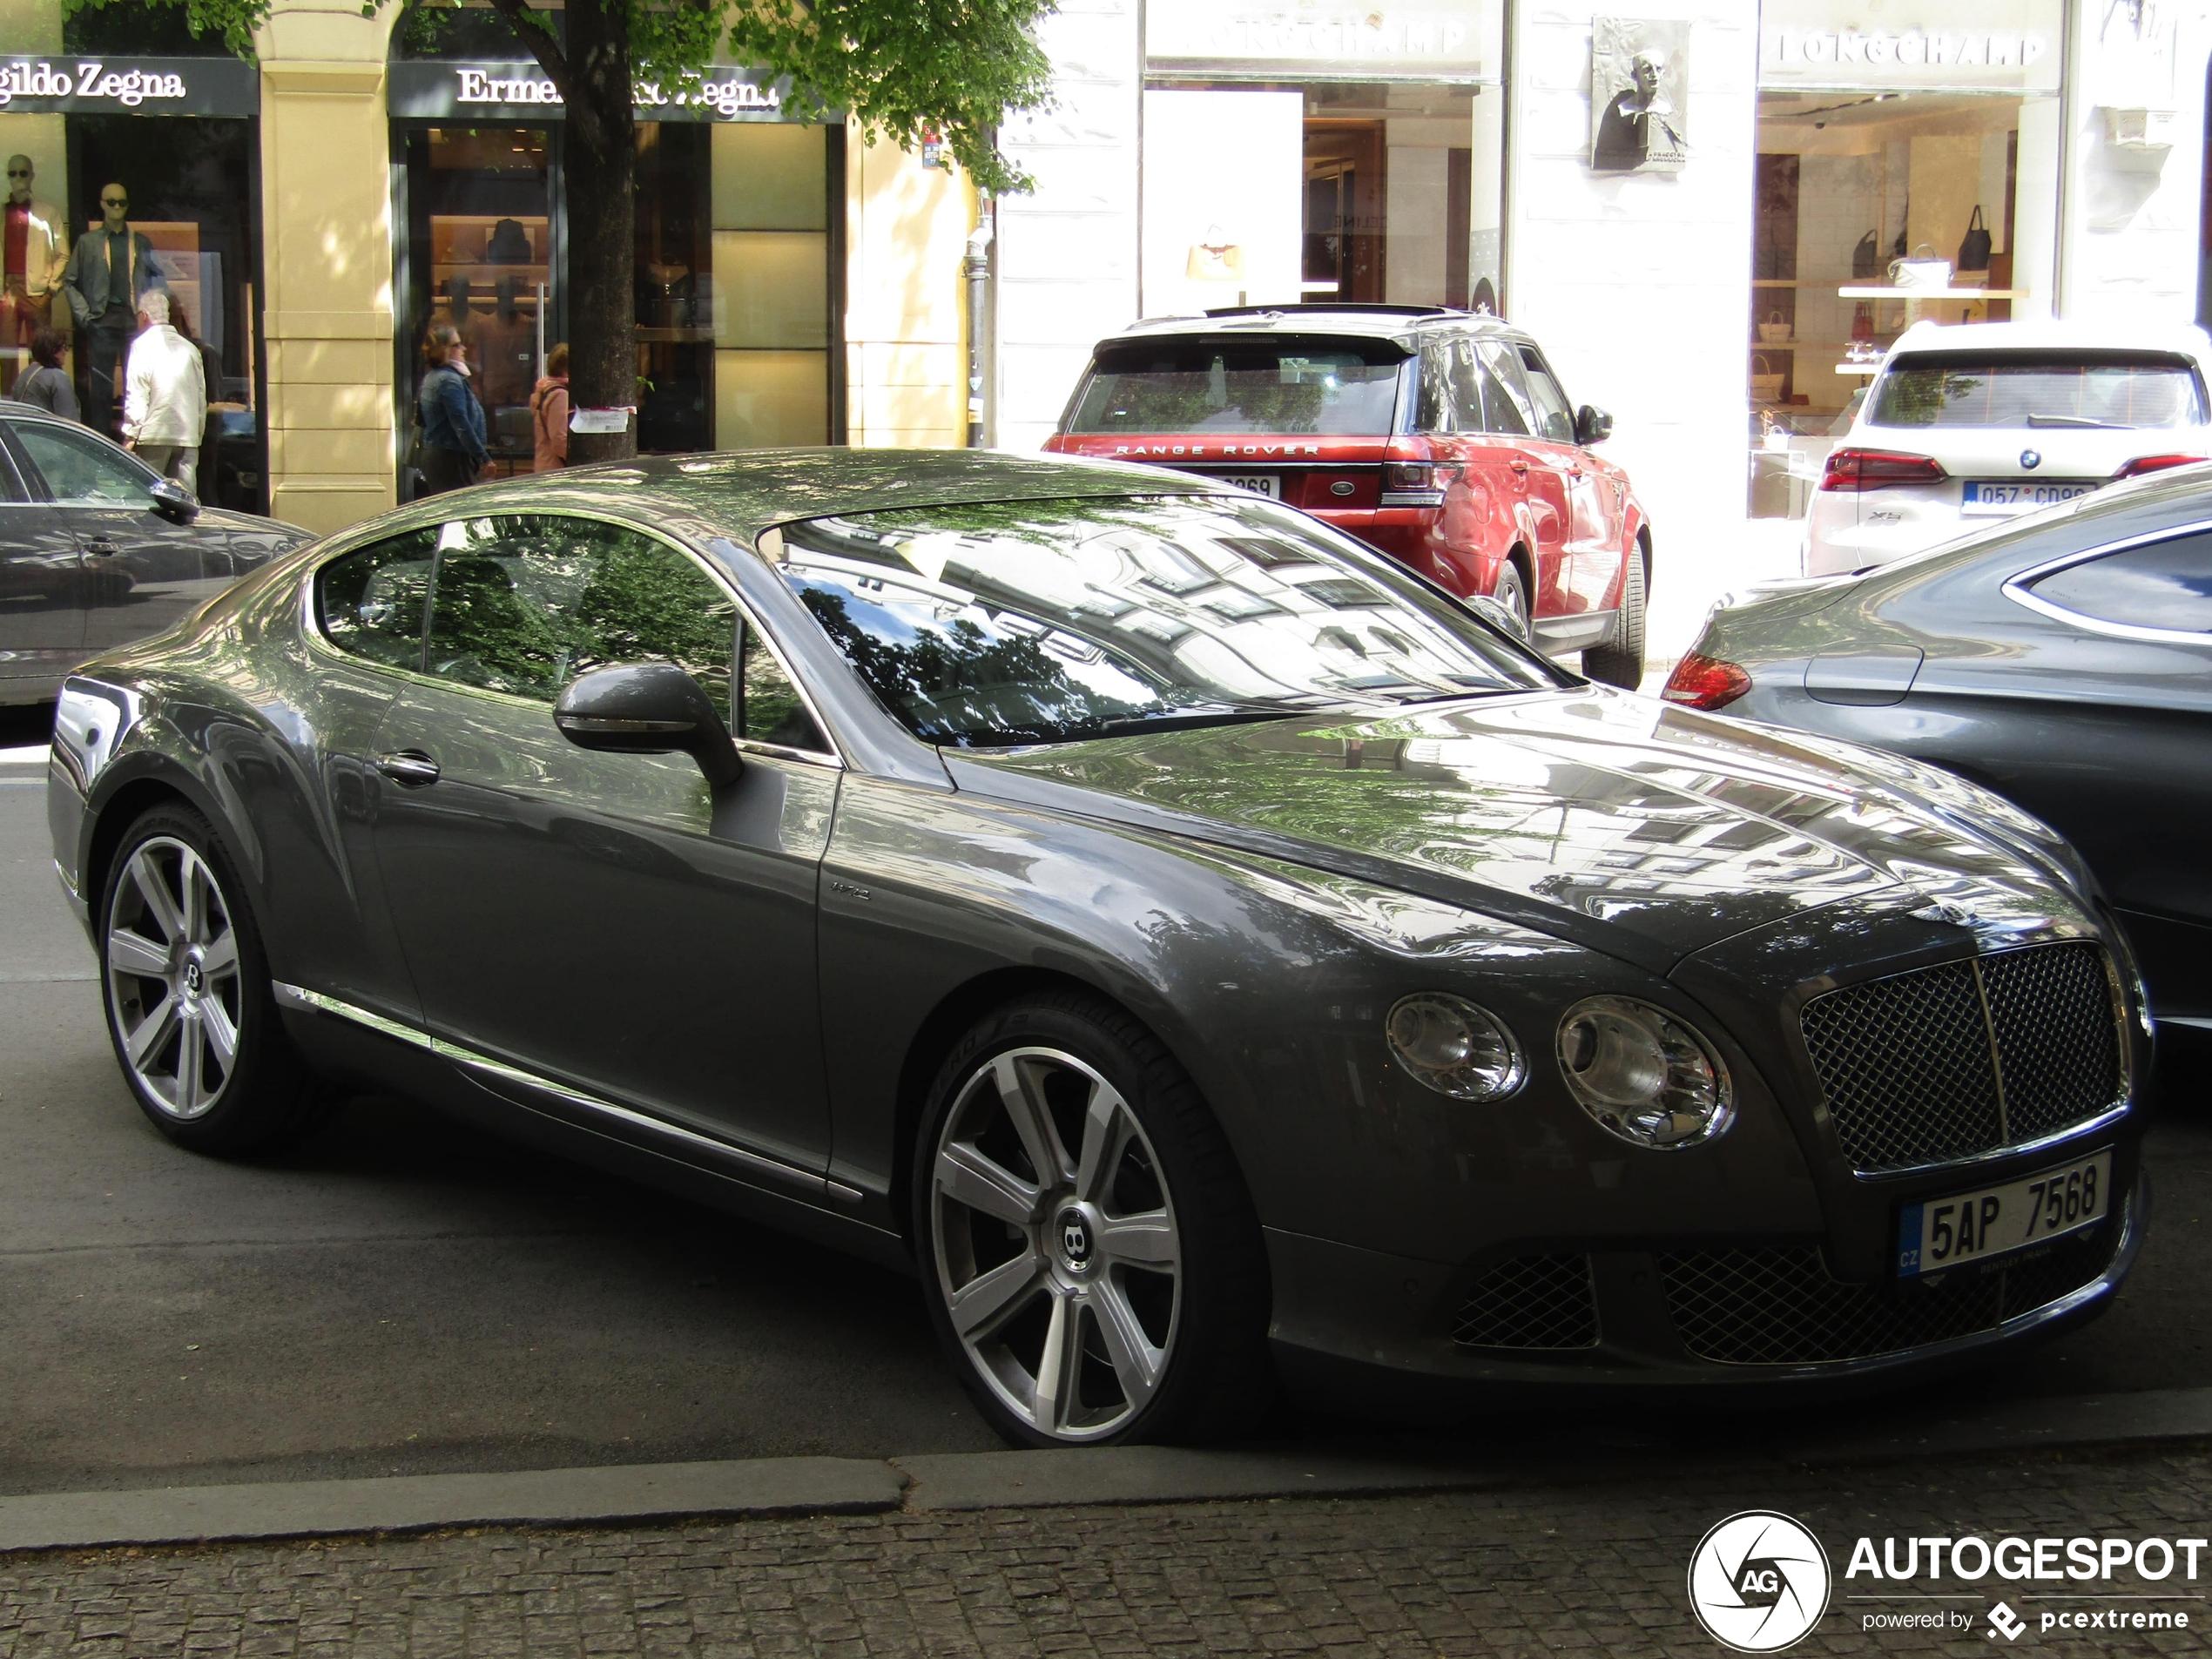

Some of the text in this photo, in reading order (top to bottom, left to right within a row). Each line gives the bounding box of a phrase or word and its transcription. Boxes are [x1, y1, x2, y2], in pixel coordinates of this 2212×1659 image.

[1185, 21, 1466, 54] ONGCHAMP
[1780, 32, 2046, 66] LONGCHAMP
[76, 63, 186, 106] Zegna
[1116, 445, 1319, 455] RANGE ROVER
[1981, 487, 2020, 505] 057
[1870, 511, 1905, 522] X5
[1931, 1163, 2097, 1260] 5AP 7568
[1900, 1249, 1919, 1268] CZ
[1979, 1256, 2020, 1274] BENTLEY
